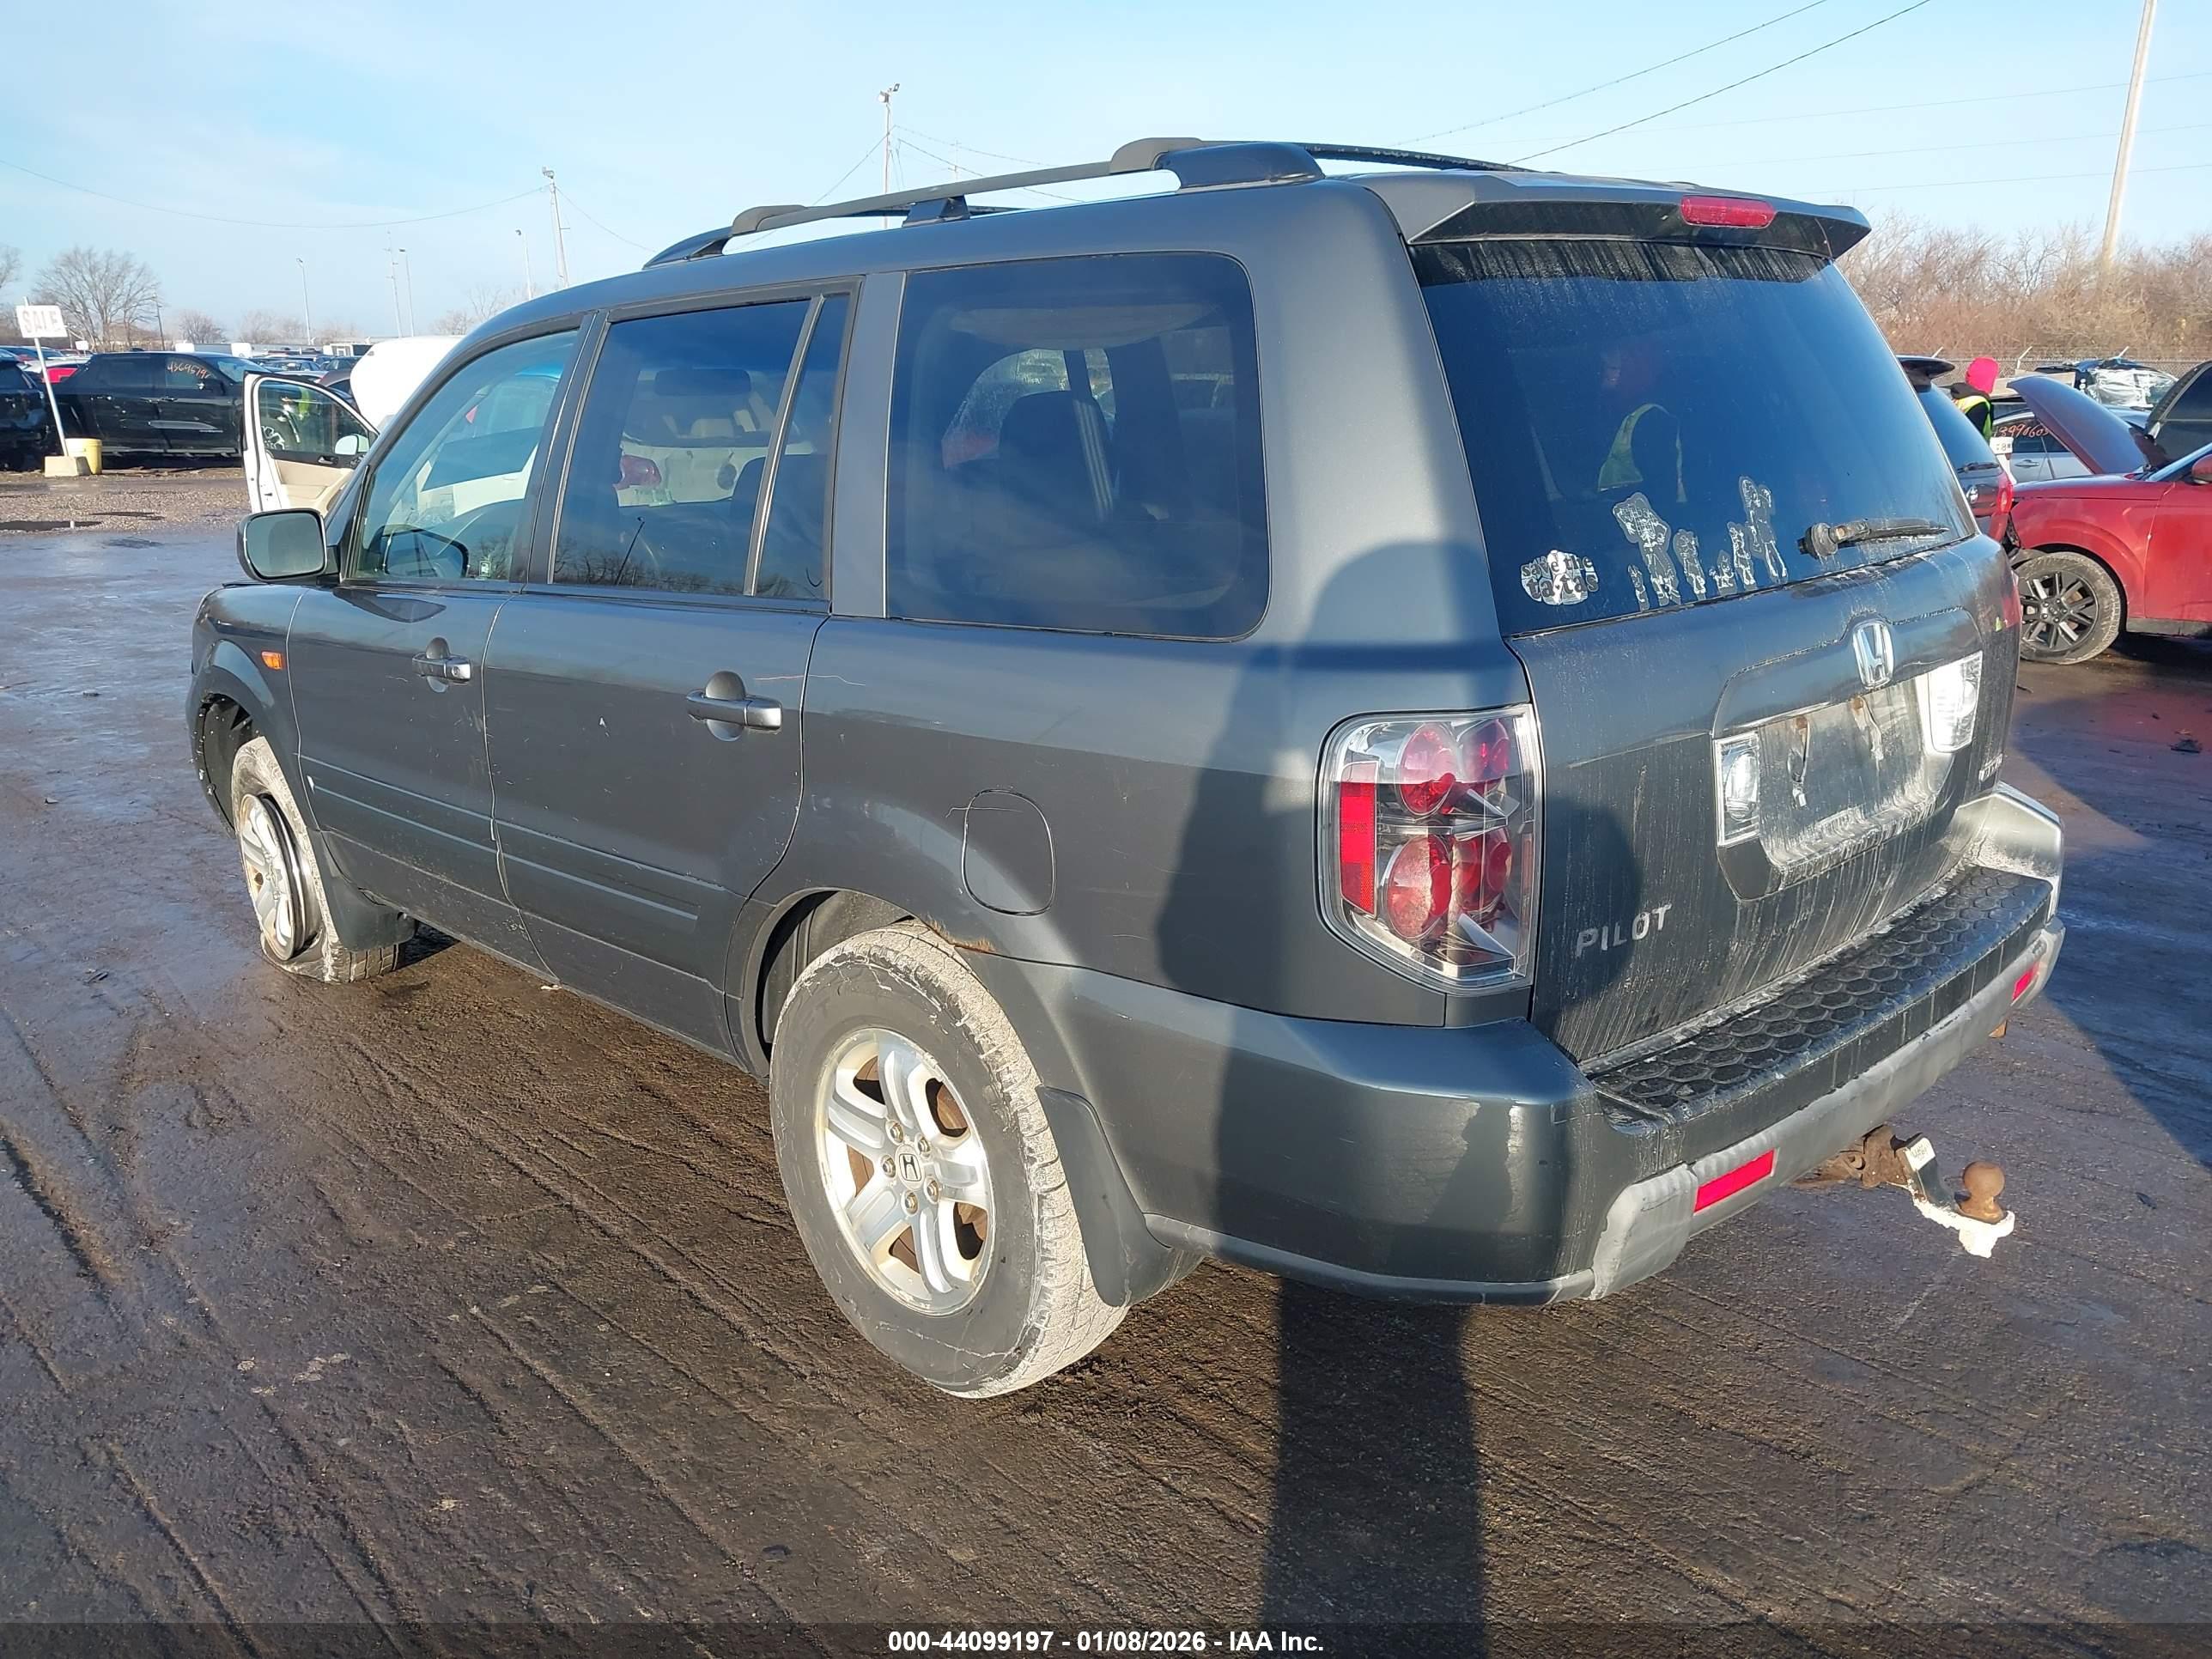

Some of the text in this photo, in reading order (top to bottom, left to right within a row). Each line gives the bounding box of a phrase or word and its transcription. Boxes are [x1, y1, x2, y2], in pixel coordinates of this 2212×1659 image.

[22, 310, 64, 332] SALE
[1522, 560, 1559, 577] save
[1563, 555, 1593, 571] the
[1576, 903, 1673, 959] PILOT
